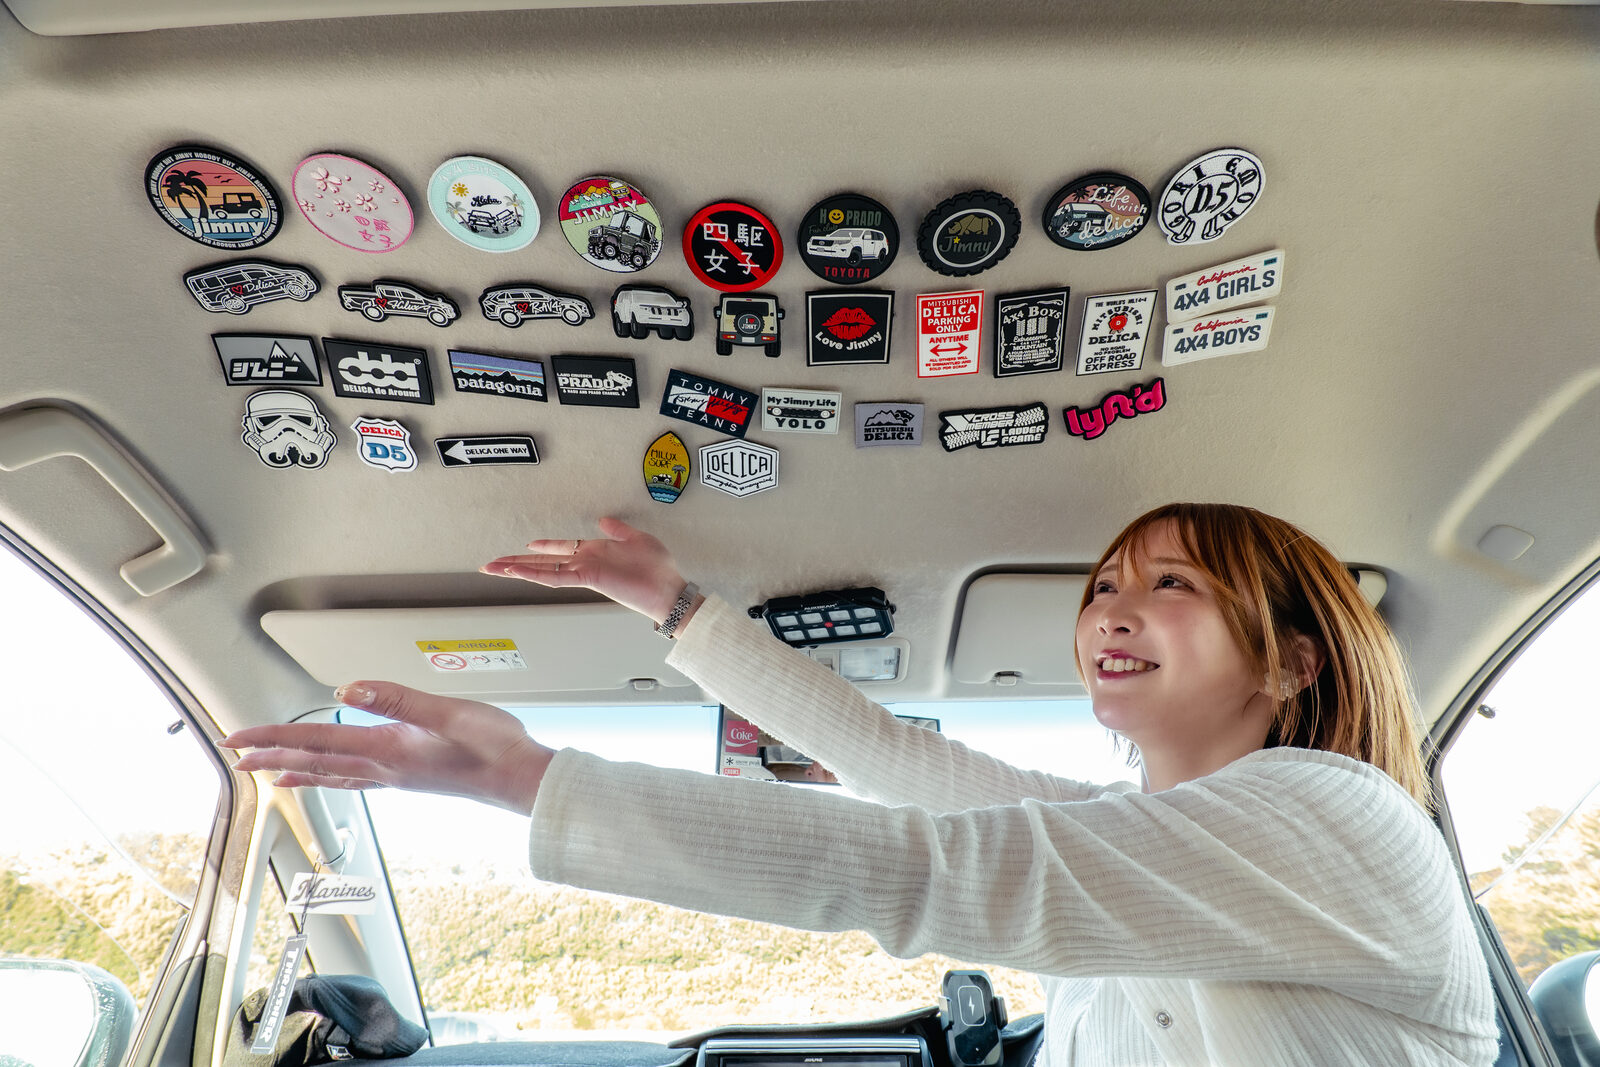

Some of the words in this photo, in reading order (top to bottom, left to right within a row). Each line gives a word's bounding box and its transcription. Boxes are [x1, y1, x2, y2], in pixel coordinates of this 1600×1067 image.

[471, 195, 502, 207] Aloha
[1088, 186, 1130, 207] Life
[1187, 180, 1236, 214] D5
[581, 200, 601, 208] CLUB
[1118, 204, 1147, 214] with
[574, 200, 637, 225] JIMNY
[846, 210, 881, 226] PRADO
[192, 218, 264, 238] jimny
[1079, 214, 1144, 239] delica
[703, 223, 764, 247] 四駆
[940, 236, 991, 258] Jimny
[704, 249, 760, 275] 女子
[824, 266, 870, 278] TOYOTA
[1197, 265, 1257, 286] California
[243, 279, 275, 292] Delica
[1216, 269, 1276, 300] GIRLS
[387, 300, 430, 310] Hilux
[529, 301, 560, 313] RAV4
[928, 298, 972, 307] MITSUBISHI
[923, 304, 976, 317] DELICA
[928, 316, 971, 326] PARKING
[1091, 306, 1143, 330] MITSUBISHI
[1193, 316, 1249, 332] California
[936, 324, 962, 332] ONLY
[815, 331, 843, 350] Love
[846, 331, 882, 350] Jimny
[929, 334, 969, 343] ANYTIME
[1088, 332, 1140, 345] DELICA
[1212, 325, 1261, 347] BOYS
[1013, 342, 1047, 350] MOUNTAIN
[1085, 356, 1106, 364] OFF
[1108, 353, 1136, 362] ROAD
[1085, 360, 1134, 371] EXPRESS
[457, 377, 543, 397] patagonia
[558, 377, 614, 388] PRADO
[343, 384, 374, 394] DELICA
[374, 387, 386, 395] de
[389, 389, 420, 398] Around
[681, 378, 748, 405] TOMMY
[767, 396, 782, 405] My
[783, 397, 815, 407] Jimny
[816, 399, 836, 407] Life
[673, 406, 737, 432] JEANS
[972, 411, 1015, 422] CROSS
[775, 418, 825, 429] YOLO
[965, 419, 1014, 431] MEMBER
[360, 426, 402, 437] DELICA
[864, 432, 914, 441] DELICA
[1001, 425, 1045, 436] LADDER
[1001, 433, 1042, 444] FRAME
[366, 443, 407, 462] D5
[648, 458, 671, 468] SURF
[712, 452, 768, 478] DELICA
[730, 727, 753, 740] Coke
[260, 947, 299, 1042] THRASHER
